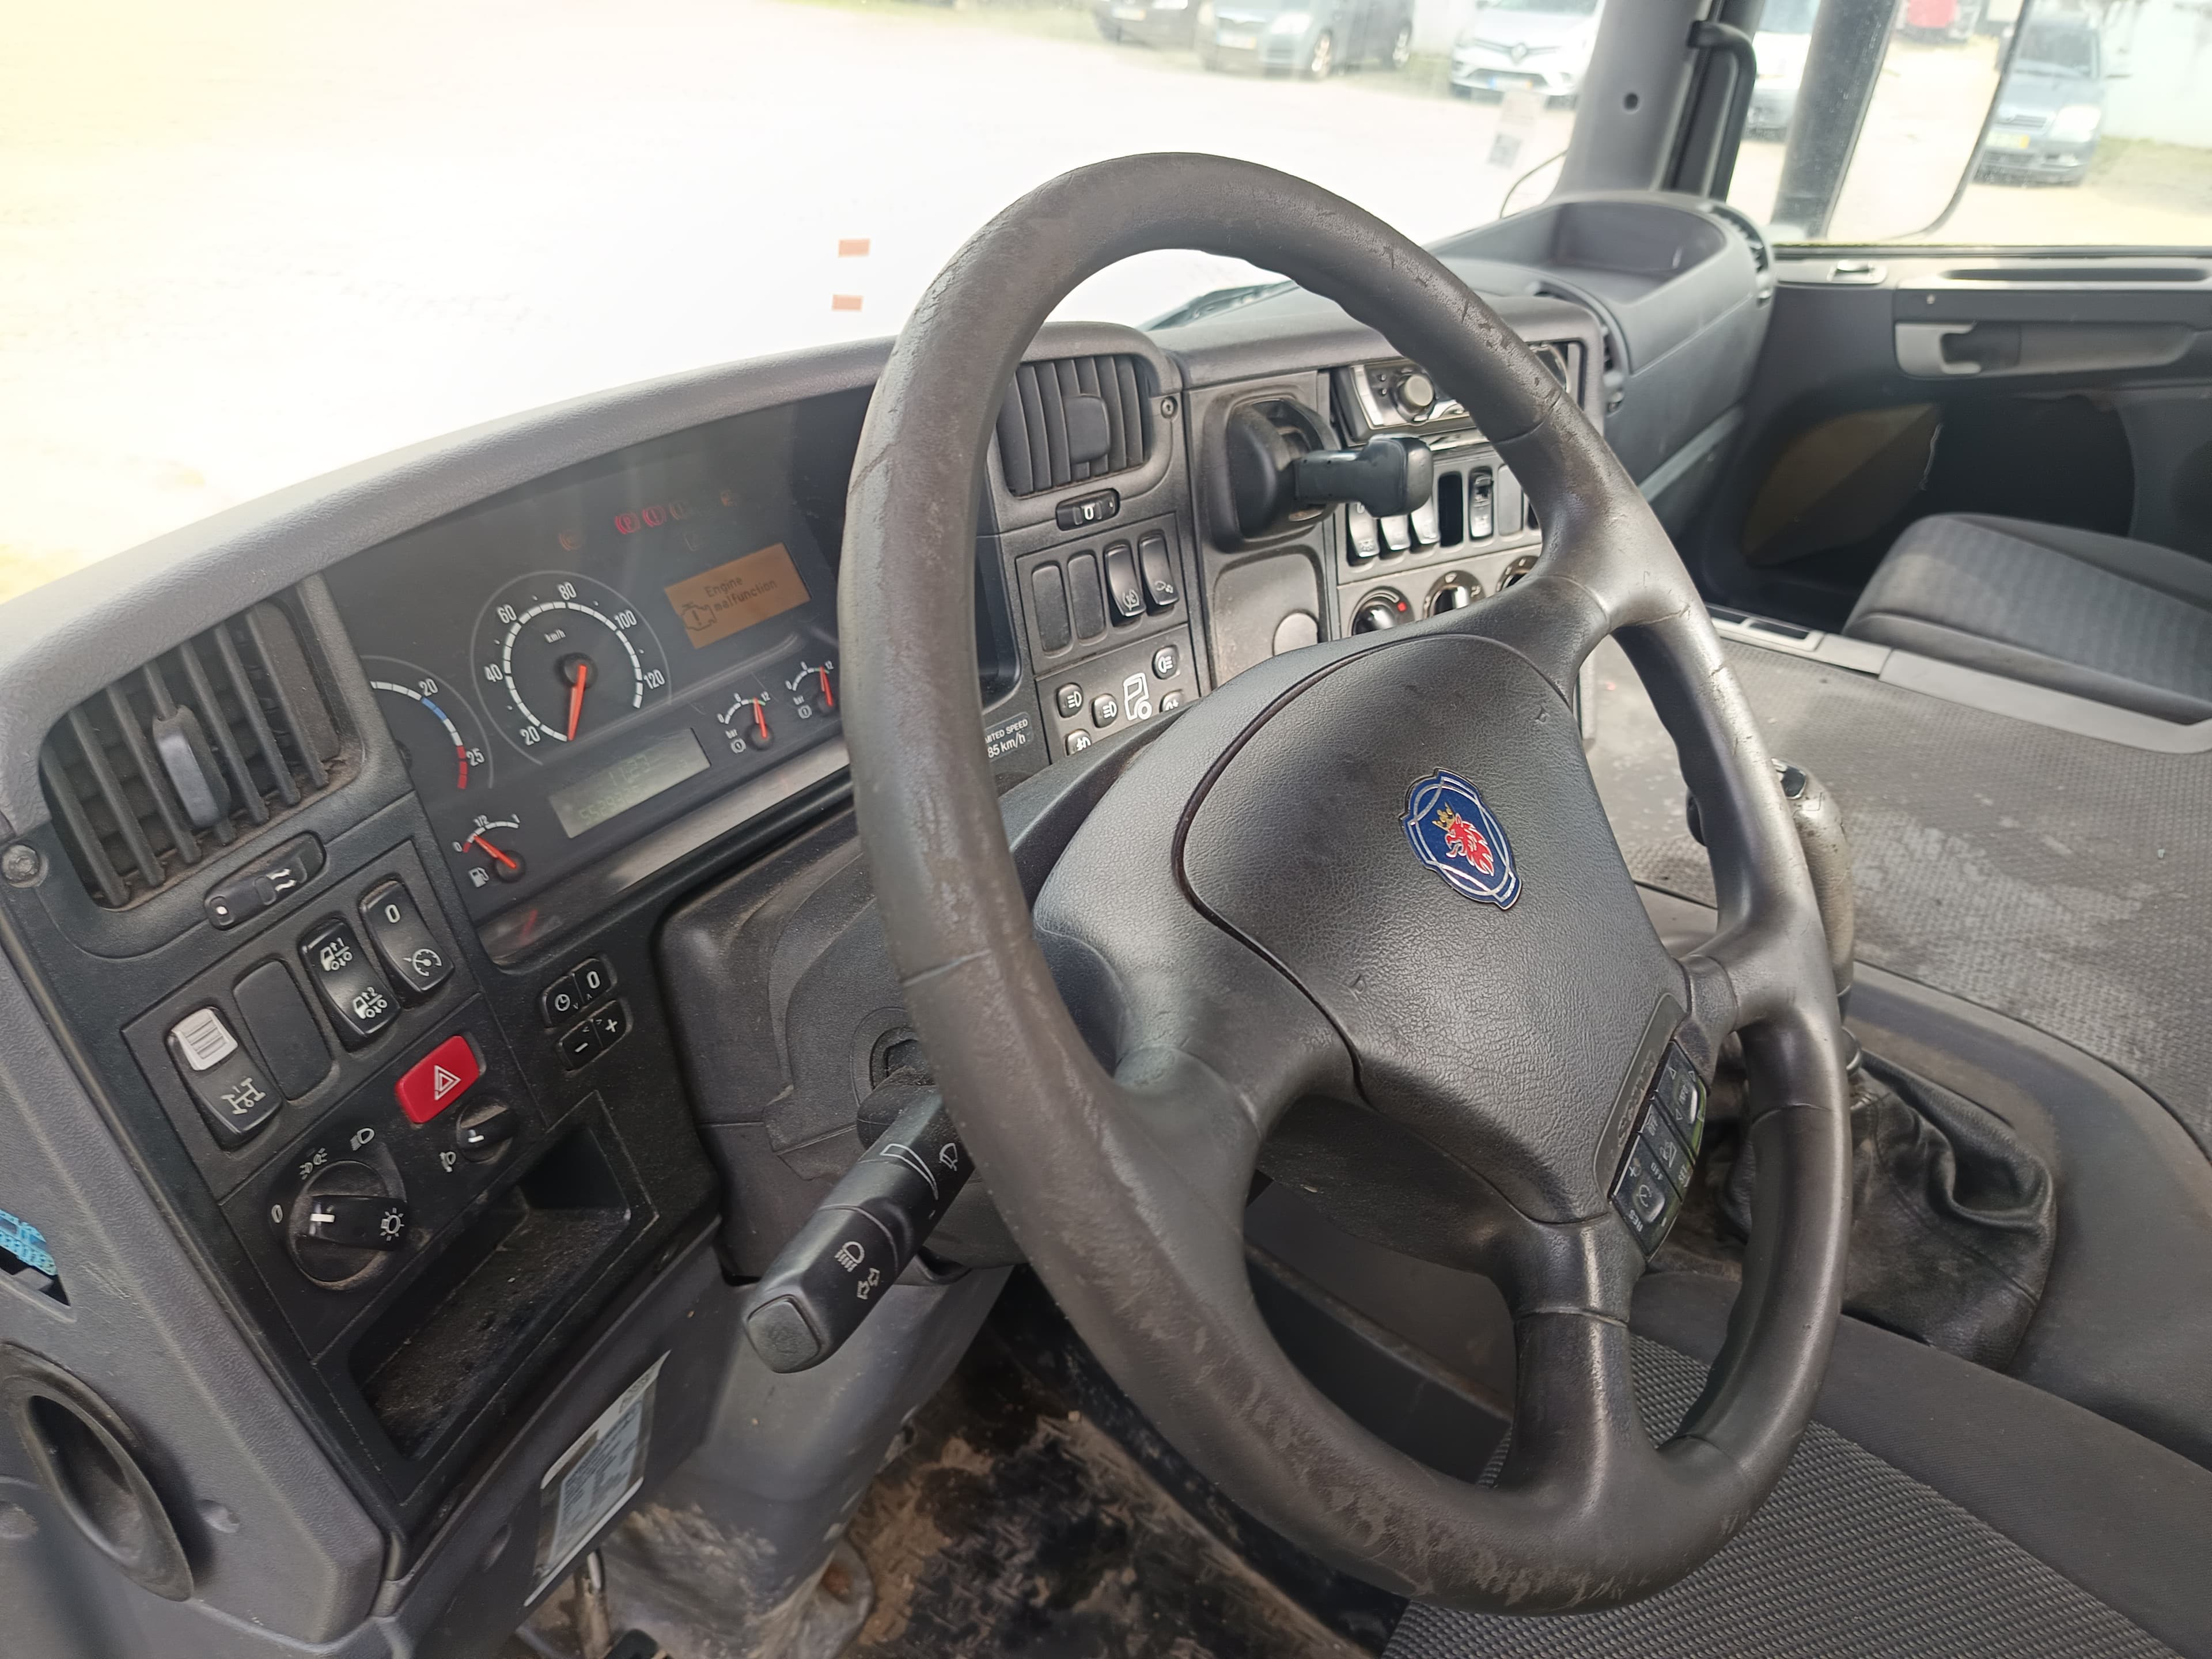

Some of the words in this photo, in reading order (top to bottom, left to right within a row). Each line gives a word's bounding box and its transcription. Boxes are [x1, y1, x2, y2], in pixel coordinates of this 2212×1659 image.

[558, 581, 577, 600] 80
[704, 577, 743, 599] Engine
[714, 580, 778, 612] malfunction
[497, 604, 517, 624] 60
[614, 609, 637, 630] 100
[543, 628, 566, 643] km/h
[483, 663, 503, 683] 40
[824, 660, 834, 670] 12
[419, 677, 438, 696] 20
[643, 668, 665, 689] 120
[760, 691, 771, 702] 12
[793, 695, 805, 705] bar
[520, 726, 541, 745] 20
[725, 729, 738, 739] bar
[984, 729, 1005, 744] MITED
[1006, 718, 1028, 734] SPEED
[987, 744, 1000, 758] 85
[1000, 732, 1026, 752] km/h
[467, 747, 485, 767] 25
[473, 815, 490, 827] 1/2
[452, 841, 463, 852] 0
[385, 904, 400, 923] 0
[586, 971, 600, 989] 0
[1650, 1162, 1664, 1180] OFF
[1628, 1209, 1643, 1232] RES
